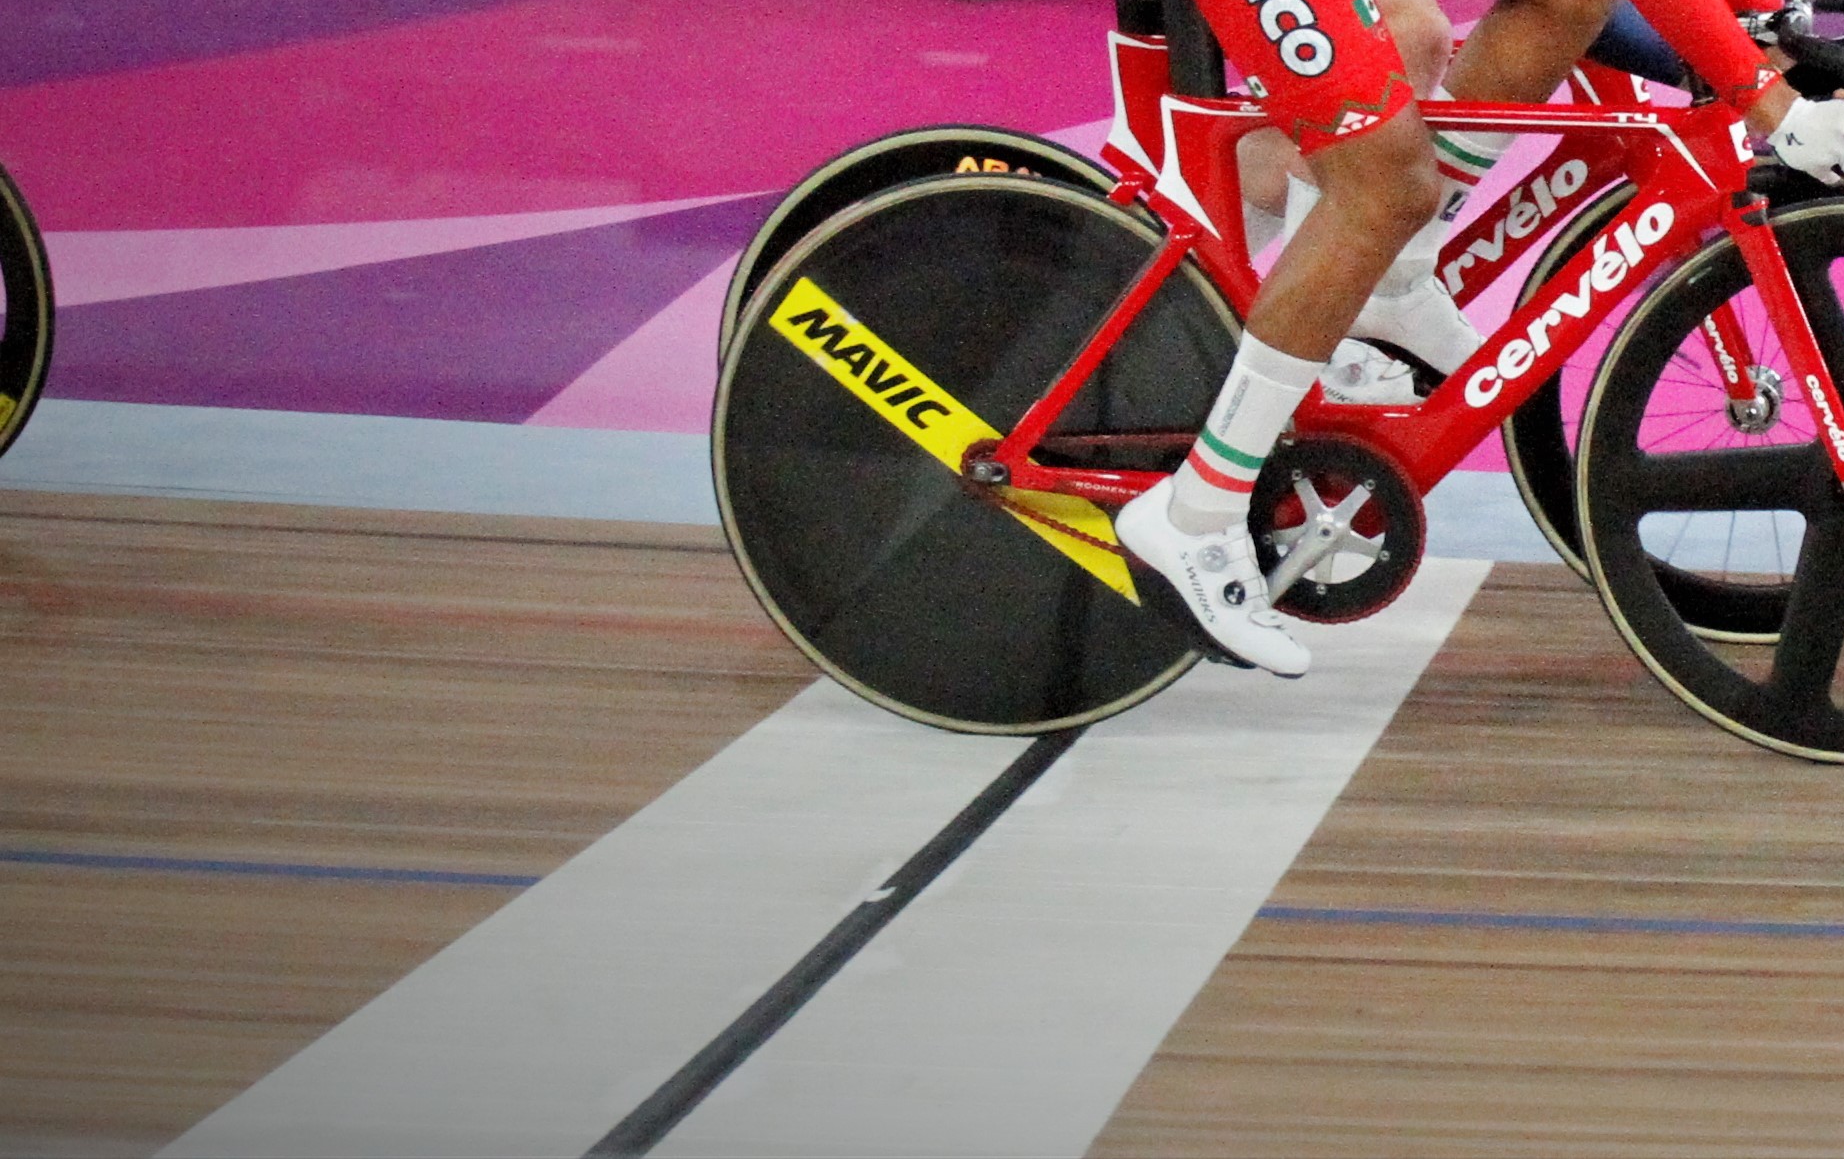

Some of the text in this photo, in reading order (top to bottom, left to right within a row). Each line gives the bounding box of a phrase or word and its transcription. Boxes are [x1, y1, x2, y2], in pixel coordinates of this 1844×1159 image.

[1442, 159, 1589, 297] rvélo
[786, 307, 953, 430] MAVIC
[1464, 202, 1675, 409] cervélo
